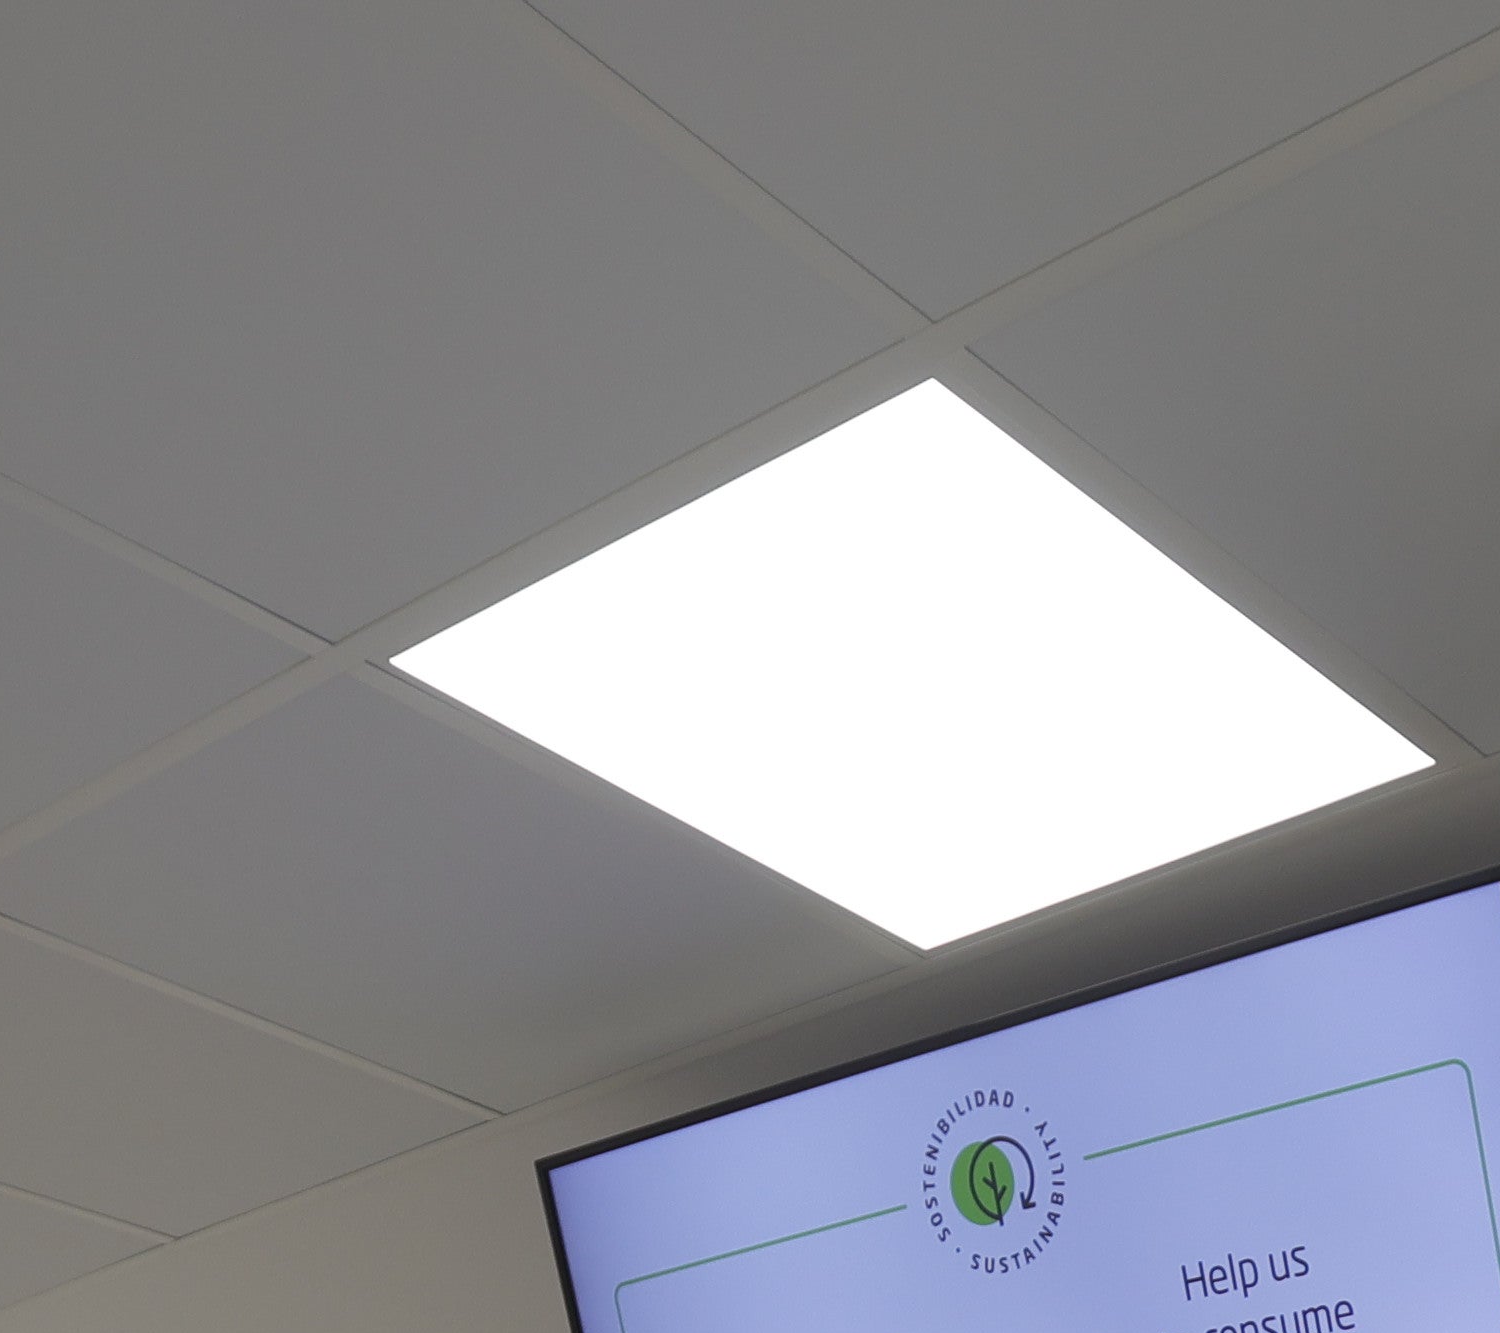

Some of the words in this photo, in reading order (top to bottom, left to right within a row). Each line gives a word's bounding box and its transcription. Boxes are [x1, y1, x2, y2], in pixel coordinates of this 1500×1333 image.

[922, 1089, 1015, 1243] SOSTENIBILIDAD
[970, 1121, 1066, 1274] SUSTAINABILITY
[1181, 1253, 1259, 1301] Help
[1268, 1245, 1310, 1282] us
